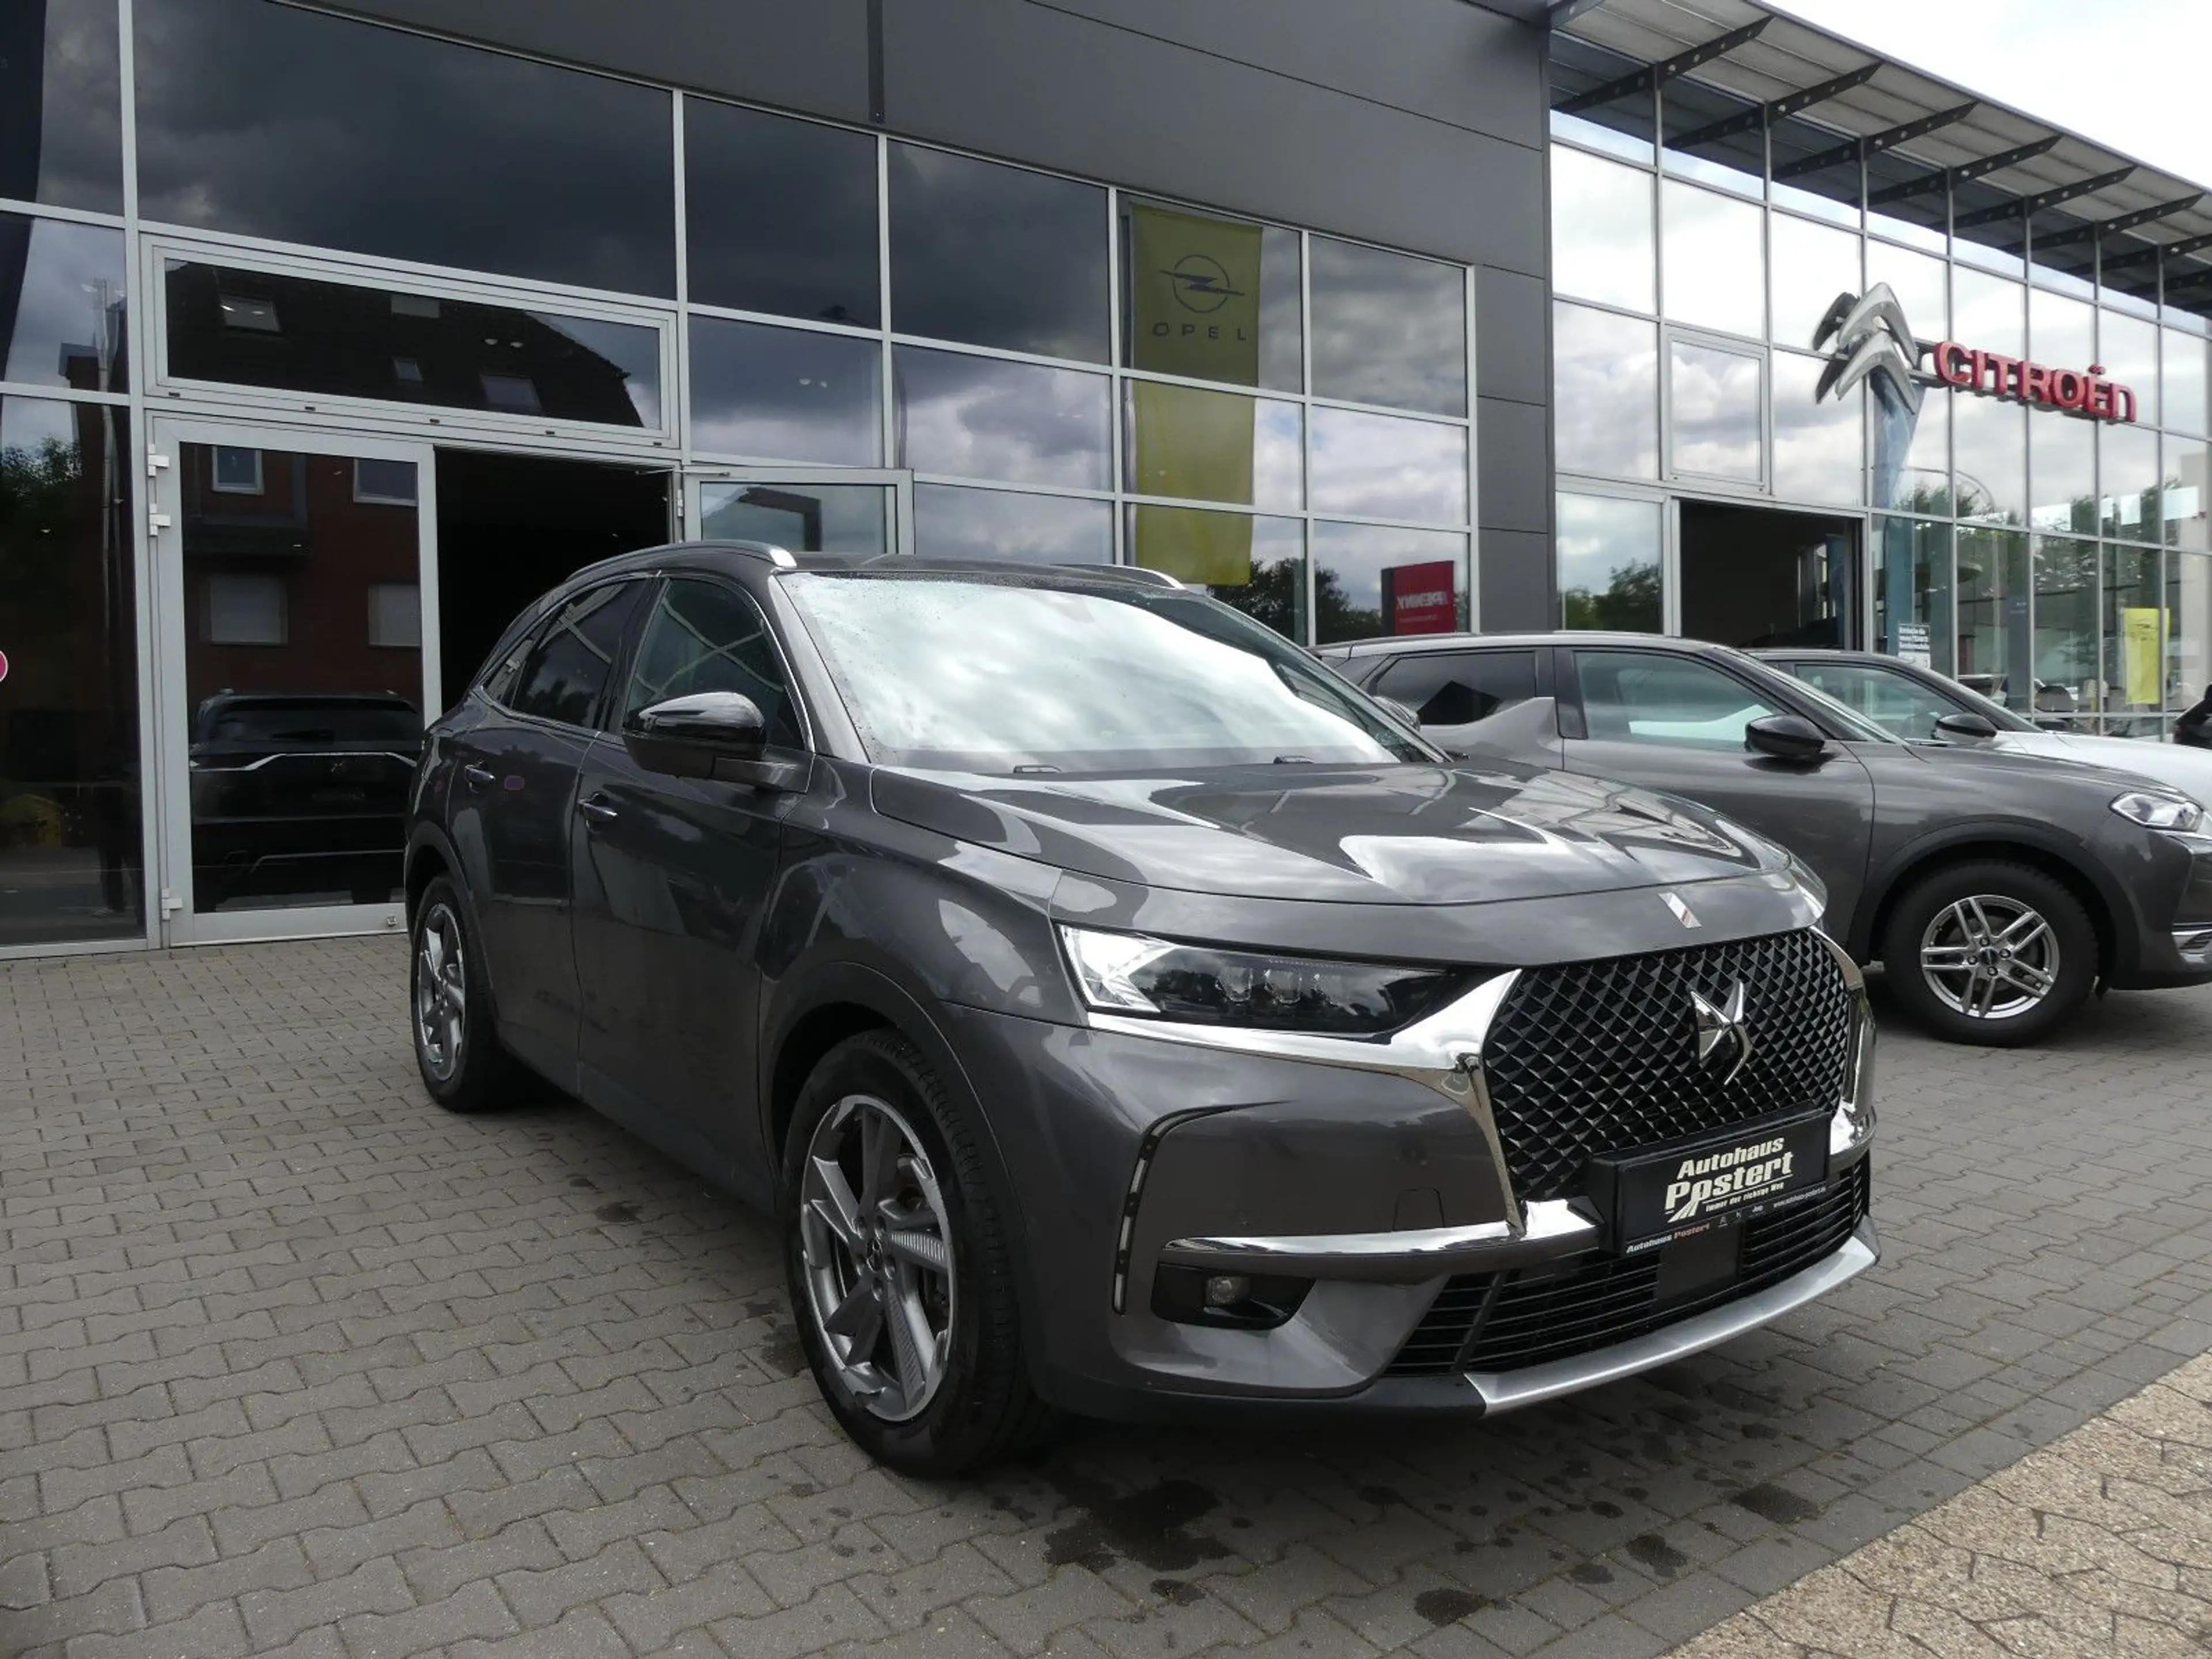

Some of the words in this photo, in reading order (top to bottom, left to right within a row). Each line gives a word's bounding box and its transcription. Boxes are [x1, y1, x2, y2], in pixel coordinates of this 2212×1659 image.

[1153, 321, 1247, 342] OPEL
[1934, 340, 2137, 423] CITROËN
[1677, 1137, 1785, 1180] Autohaus
[1664, 1151, 1794, 1215] Postert
[1626, 1234, 1672, 1253] Autohaus
[1674, 1222, 1710, 1238] Postert
